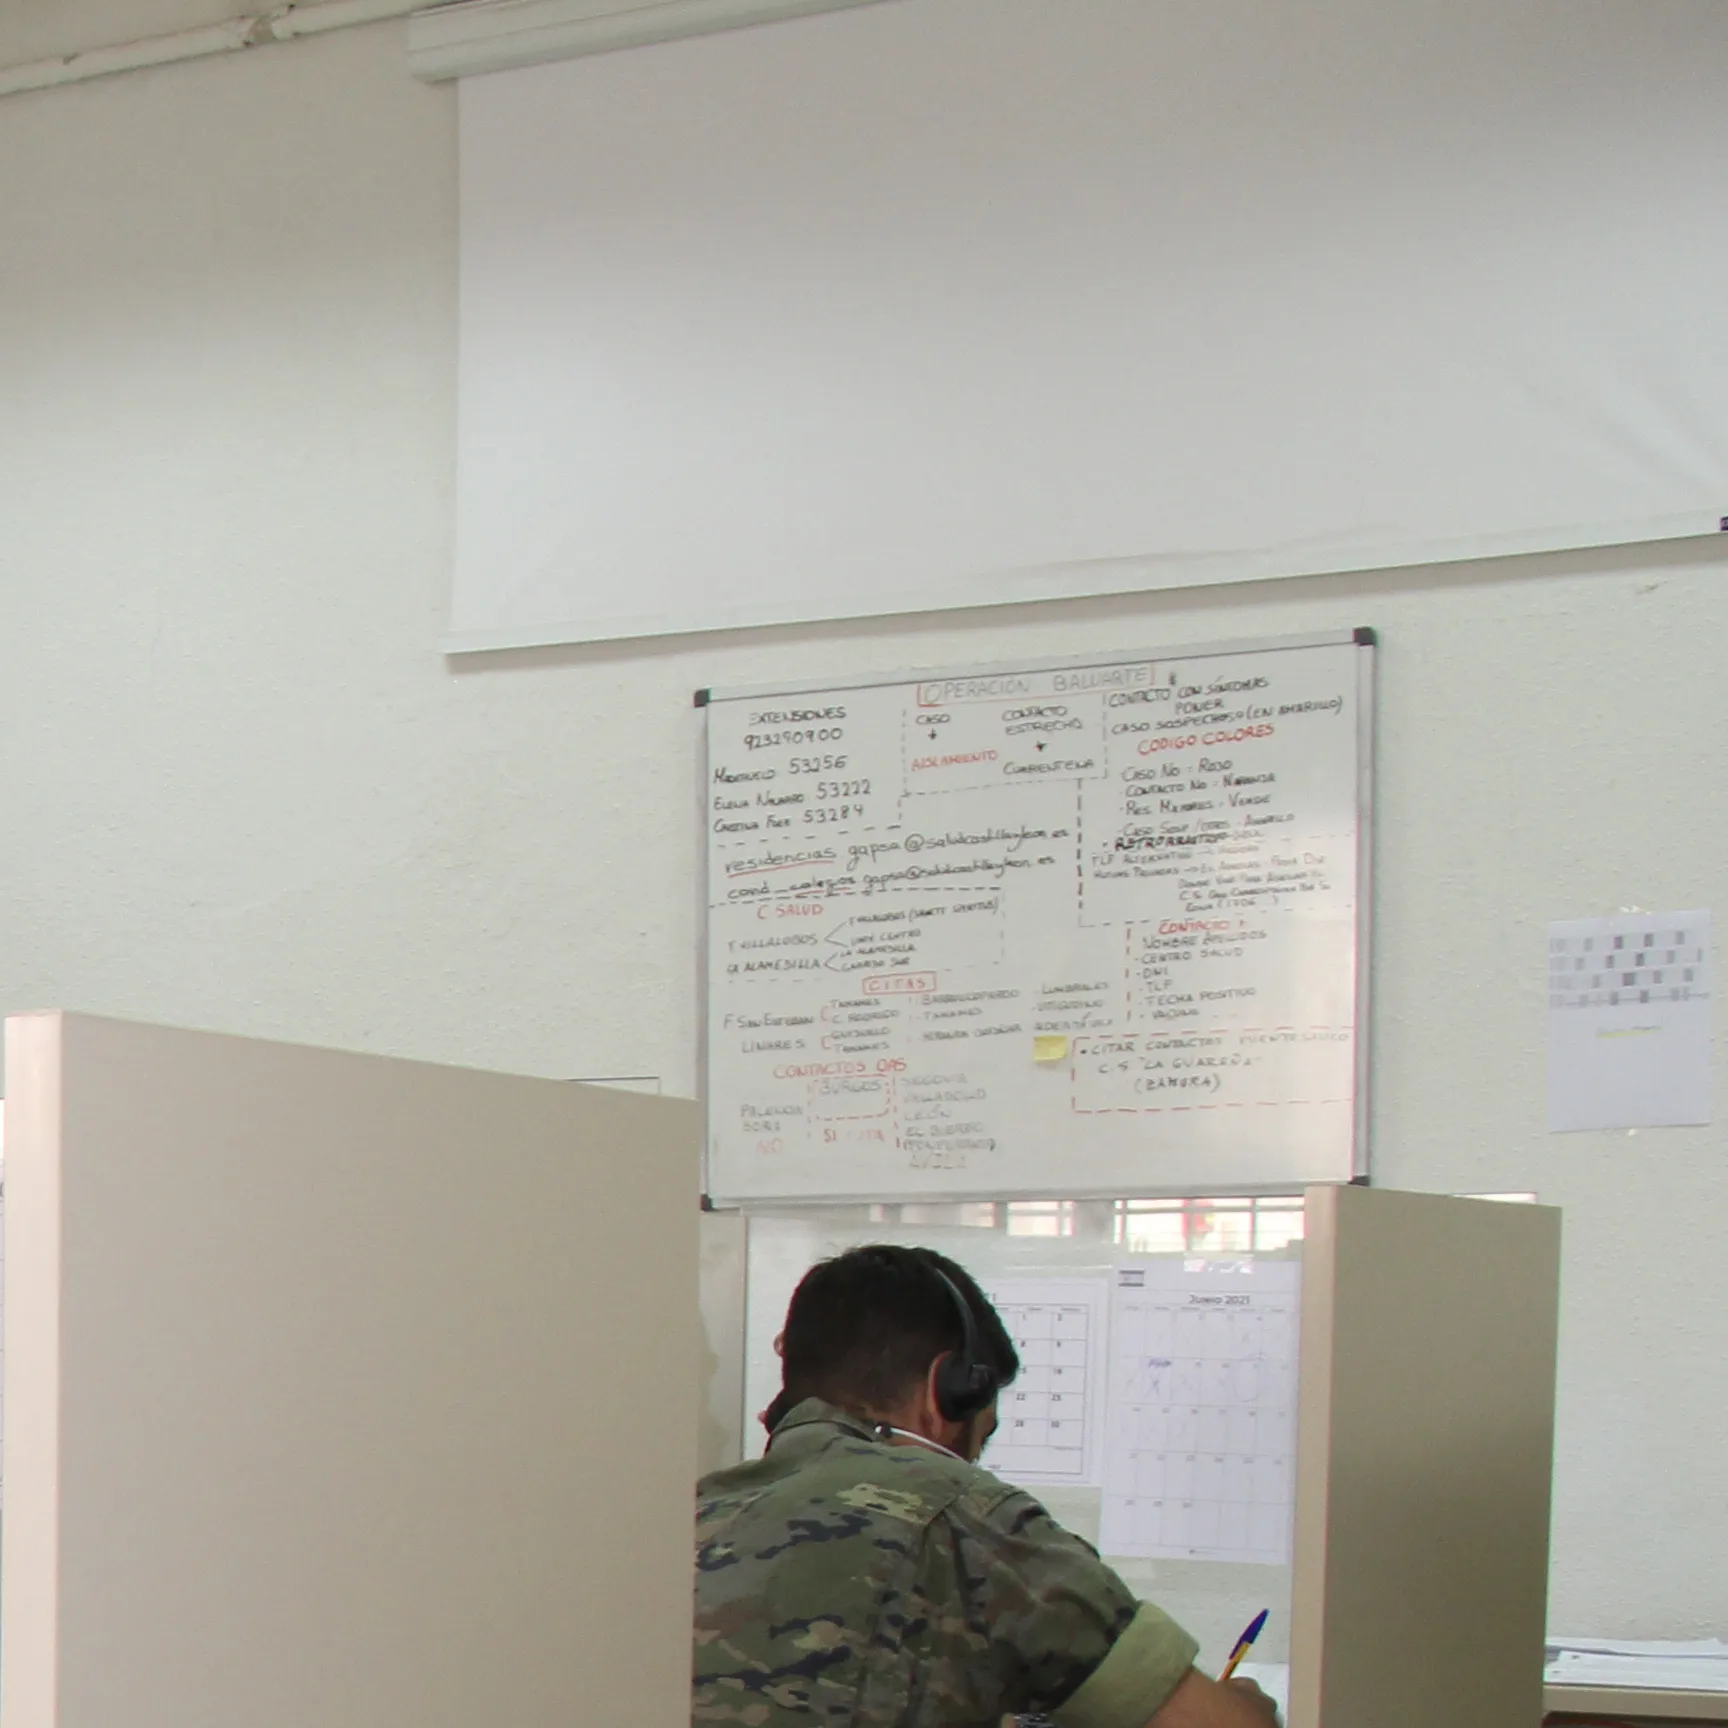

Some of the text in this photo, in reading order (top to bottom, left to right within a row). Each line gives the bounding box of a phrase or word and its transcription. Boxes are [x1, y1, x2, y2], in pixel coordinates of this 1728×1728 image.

[924, 667, 1148, 704] OPERACIÓN BALUARTE
[749, 706, 847, 726] EXTENSIONES
[1202, 722, 1275, 745] COLORES
[789, 755, 848, 774] 53256
[817, 779, 872, 799] 53222
[803, 804, 864, 823] 53284
[725, 847, 837, 873] residencias
[776, 903, 824, 918] SALUD
[1091, 1041, 1135, 1055] CITAR
